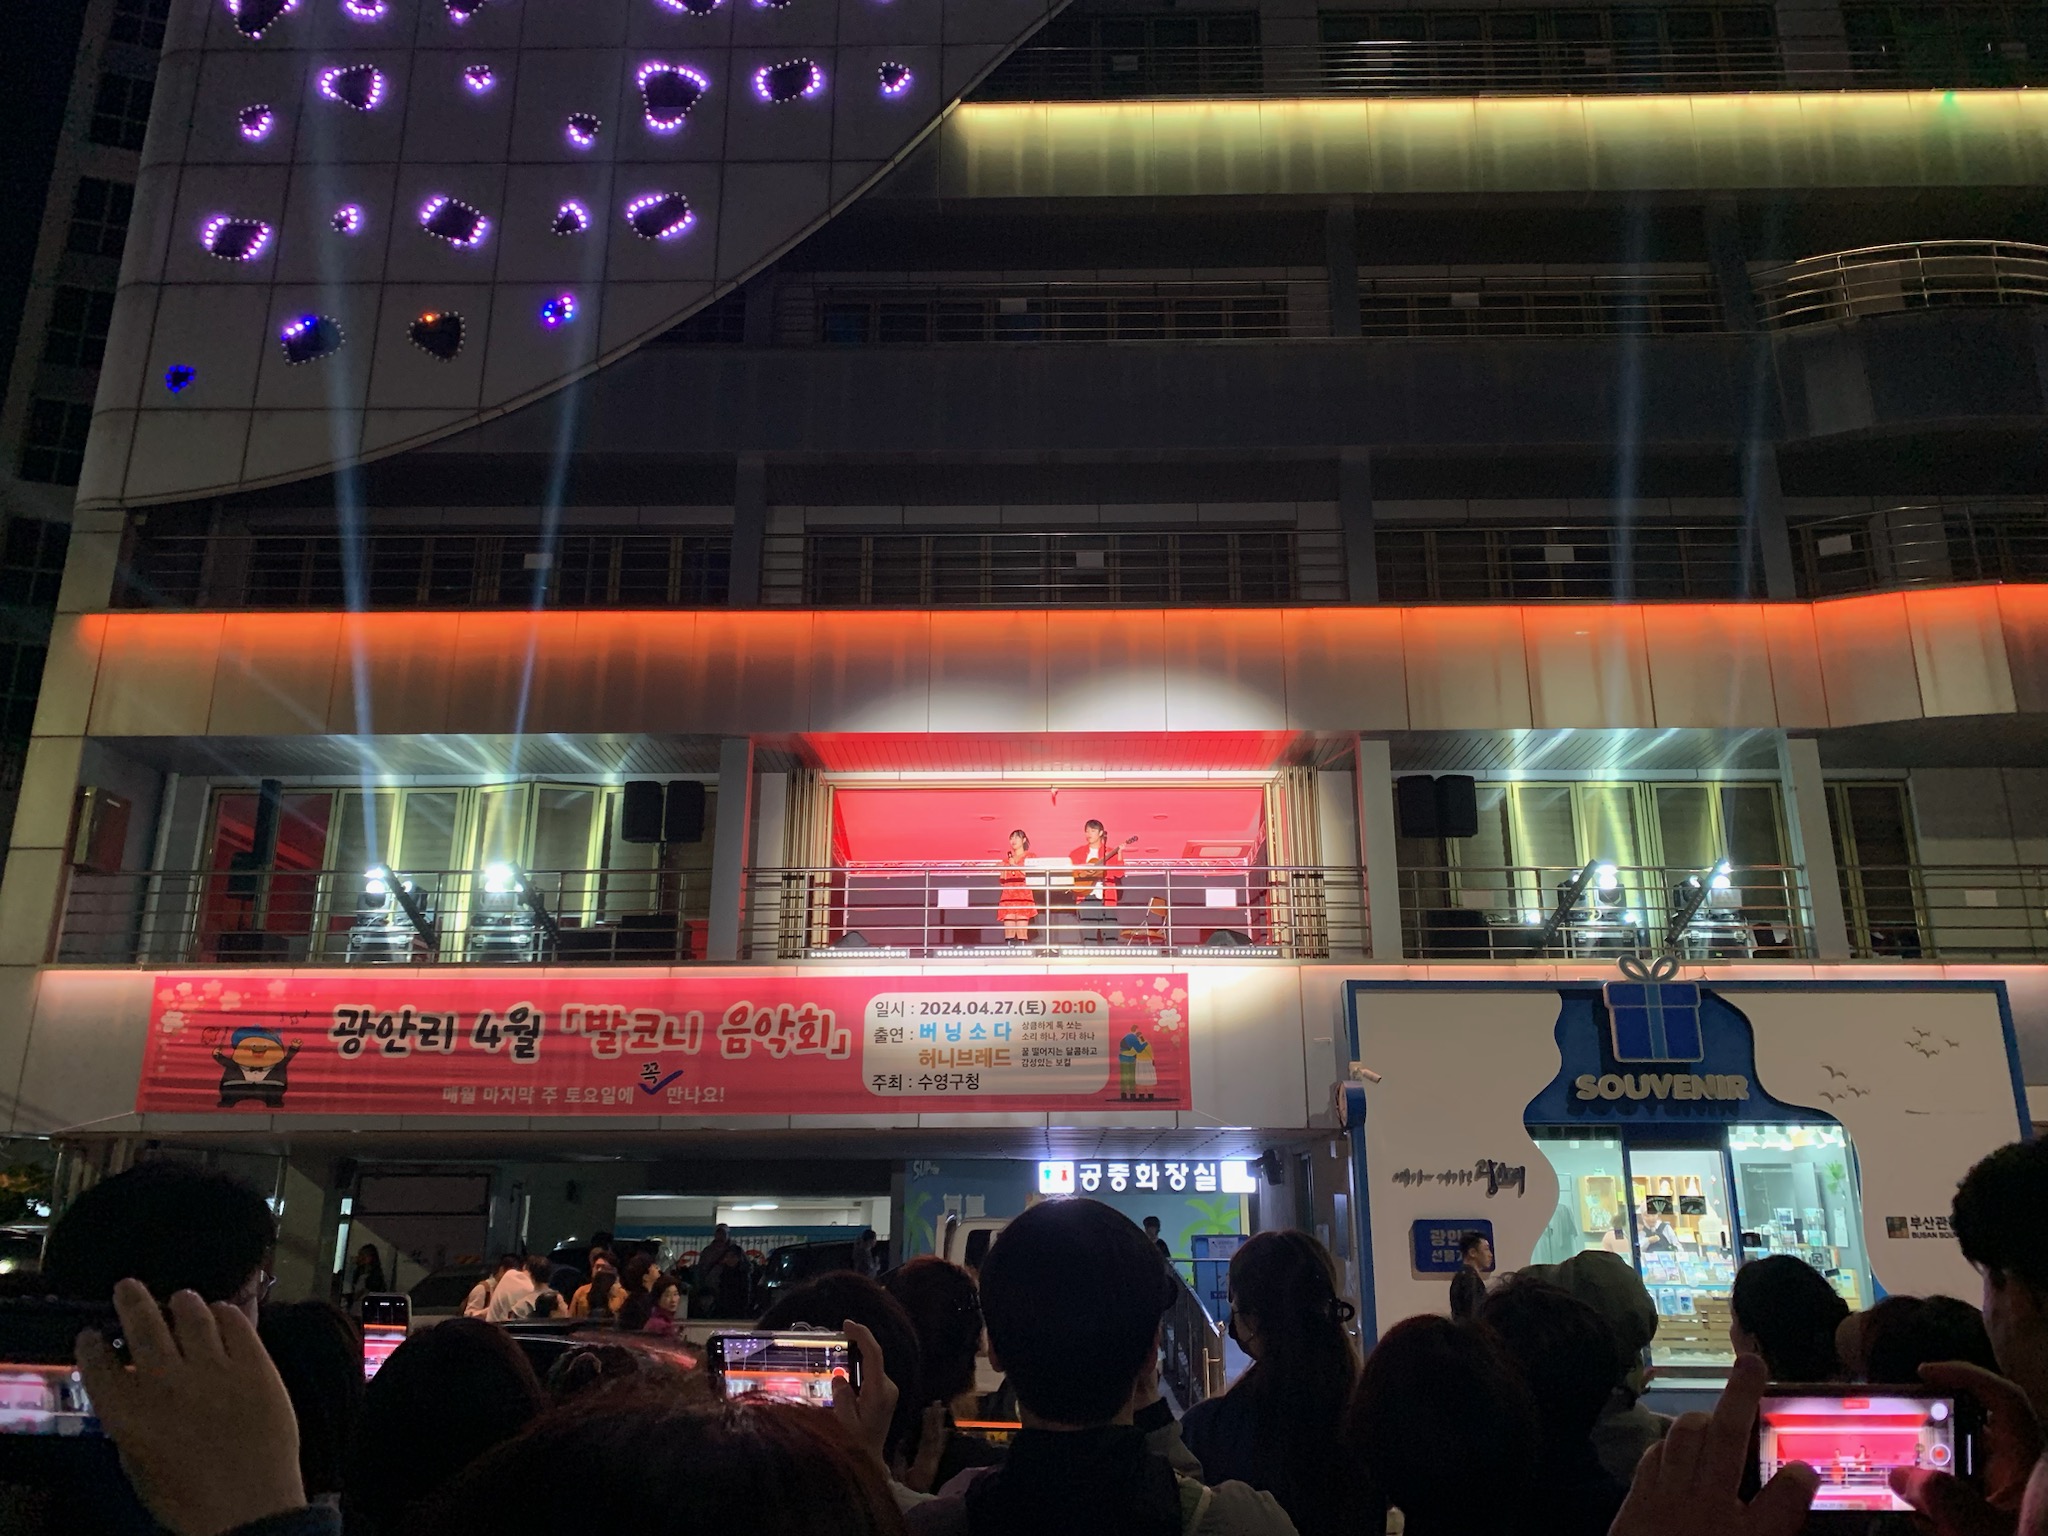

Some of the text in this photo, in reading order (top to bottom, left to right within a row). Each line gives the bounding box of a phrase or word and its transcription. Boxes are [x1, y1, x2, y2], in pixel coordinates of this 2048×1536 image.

[874, 1001, 904, 1018] 일시
[1052, 1000, 1096, 1014] 20:10
[332, 1008, 455, 1056] 광안리
[473, 1006, 542, 1059] 4월
[874, 1026, 904, 1044] 출연
[1022, 1032, 1038, 1040] 소리
[1060, 1032, 1076, 1040] 기타
[1079, 1032, 1095, 1040] 하나
[919, 1047, 1012, 1068] 허니브레드
[1022, 1058, 1053, 1068] 감성있는
[640, 1061, 661, 1084] 꼭
[872, 1074, 902, 1092] 주최
[918, 1072, 980, 1091] 수영구청
[442, 1086, 725, 1105] 매월 마지막 주 토요일에 만나요!
[1575, 1073, 1750, 1101] SOUVENIR
[1079, 1161, 1217, 1193] 공중화장실
[1910, 1215, 1950, 1230] 부산관
